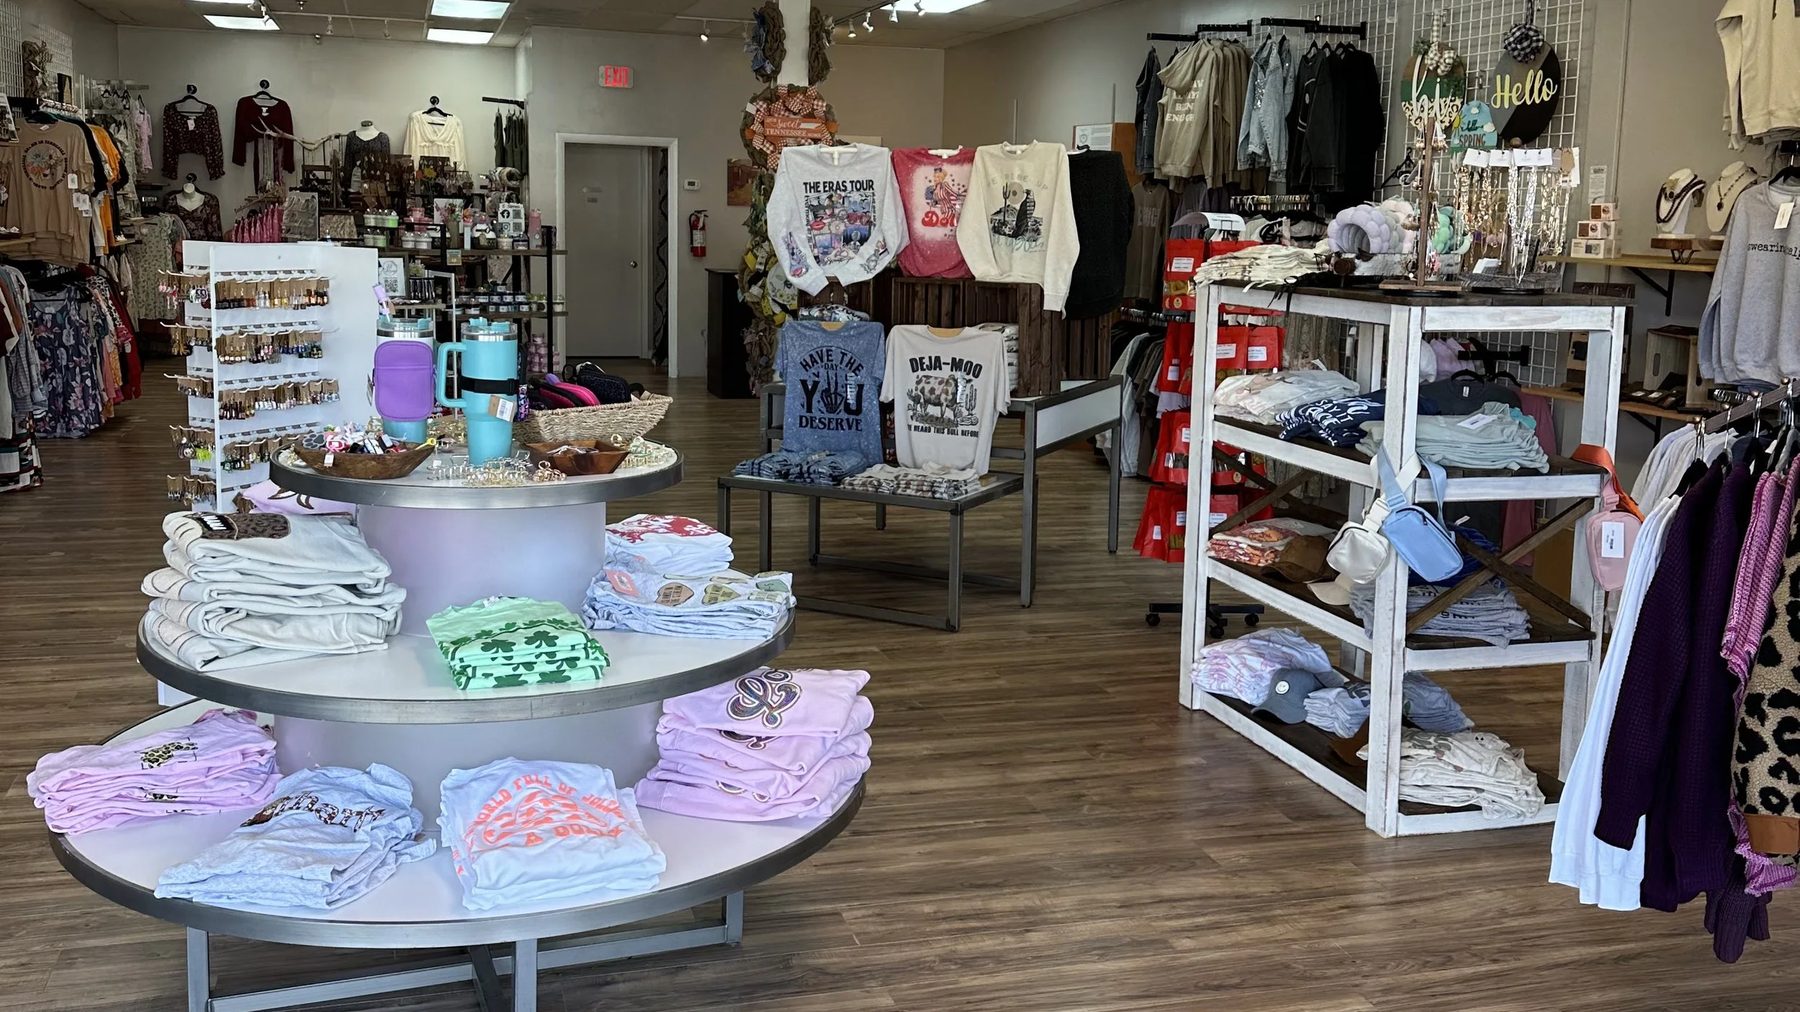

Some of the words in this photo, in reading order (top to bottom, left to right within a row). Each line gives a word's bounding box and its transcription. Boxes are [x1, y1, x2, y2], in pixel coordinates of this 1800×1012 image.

[604, 64, 629, 88] EXIT
[1491, 69, 1558, 109] Hello
[766, 128, 807, 137] TENNESSEE
[1459, 133, 1486, 147] SPRING
[803, 181, 822, 194] THE
[823, 180, 848, 193] ERAS
[849, 179, 875, 192] TOUR
[800, 348, 834, 372] HAVE
[839, 351, 864, 377] THE
[824, 362, 840, 371] DAY
[909, 355, 983, 379] DEJA-MOO
[1315, 399, 1341, 412] SAY
[799, 415, 863, 432] DESERVE
[557, 783, 578, 795] OF
[525, 832, 543, 846] A
